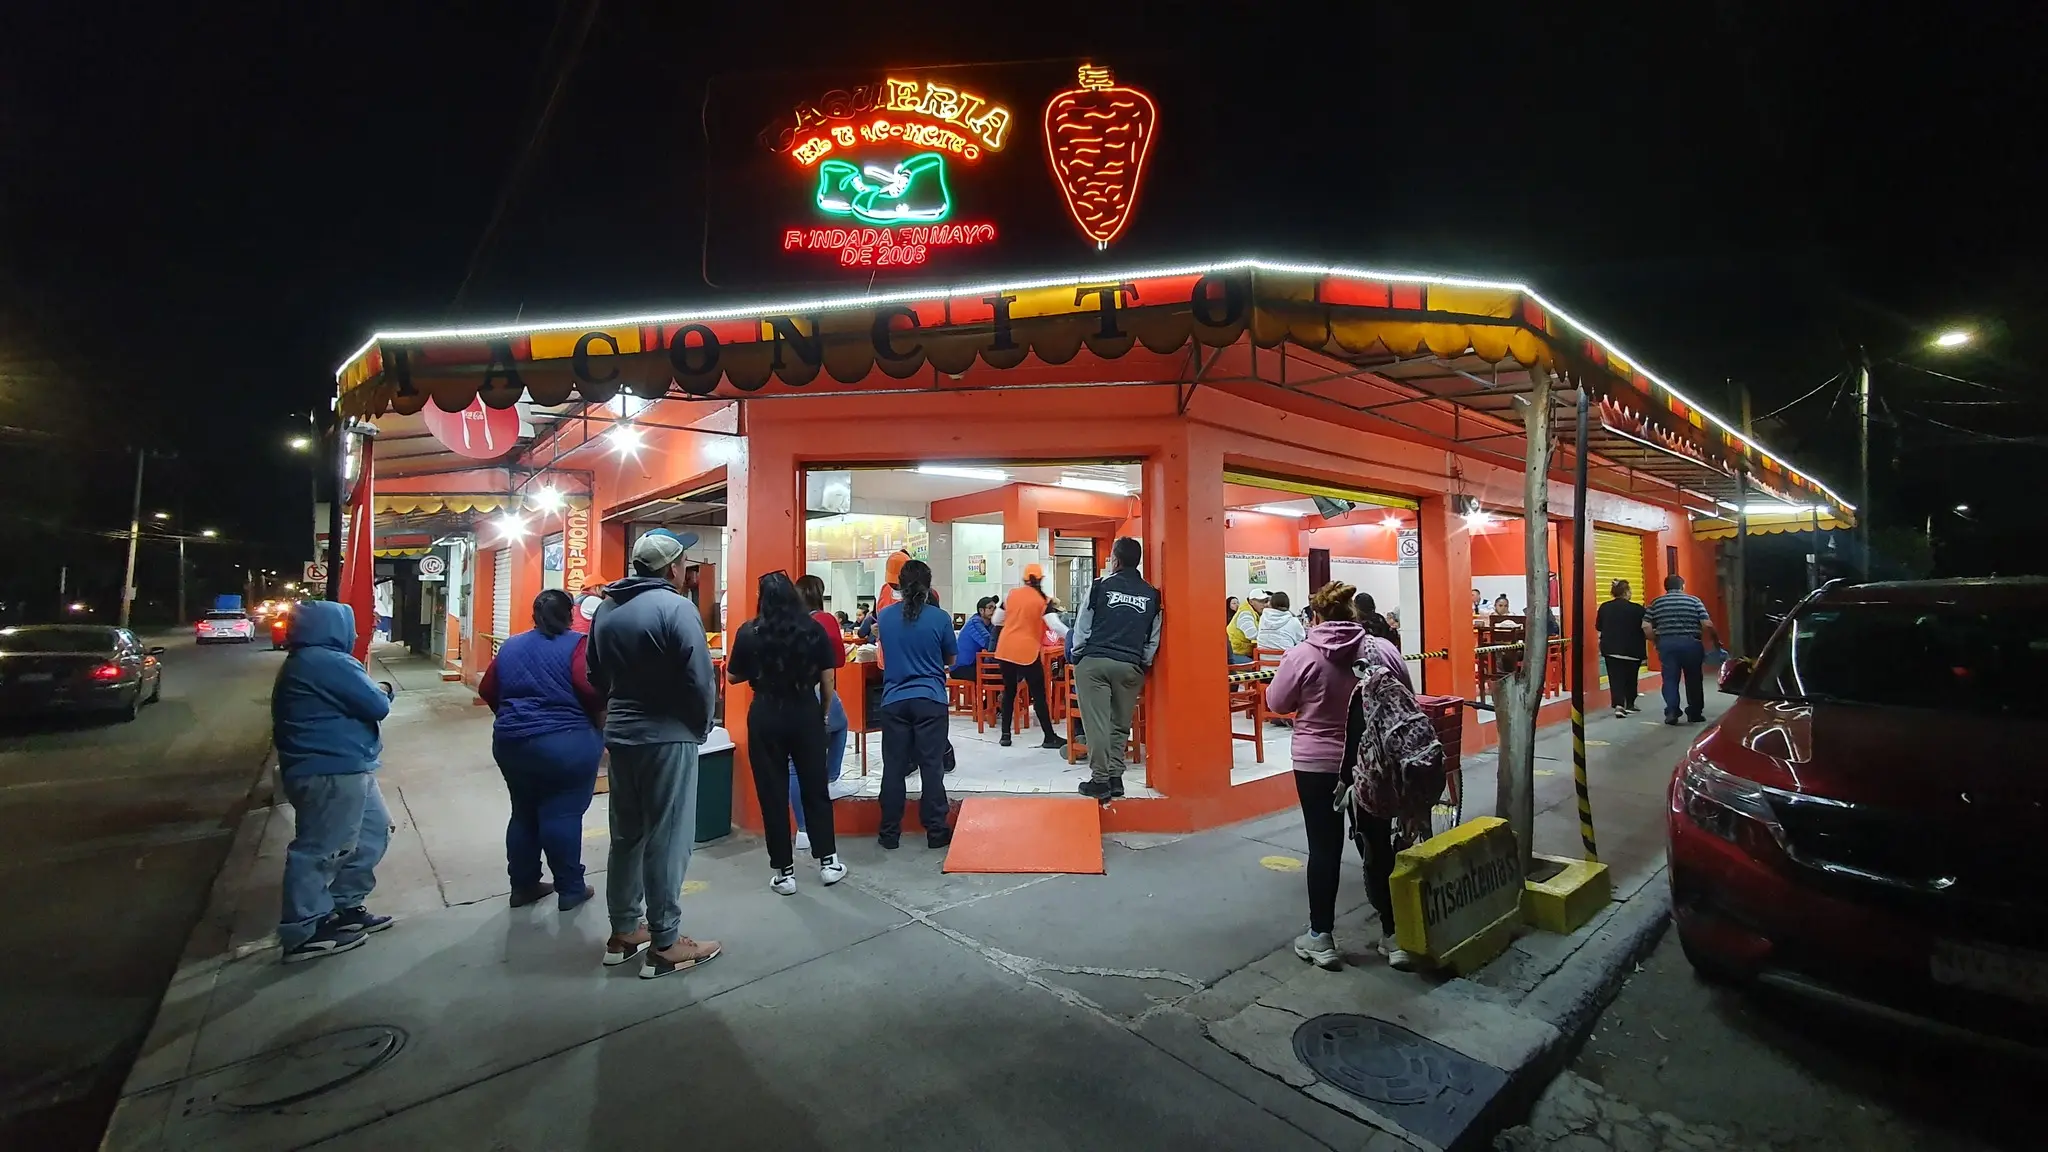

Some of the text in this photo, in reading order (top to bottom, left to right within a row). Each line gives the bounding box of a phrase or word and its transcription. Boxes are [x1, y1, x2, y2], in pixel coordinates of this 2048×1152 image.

[792, 137, 833, 165] EL
[928, 223, 996, 246] MAYO
[840, 247, 875, 267] DE
[383, 272, 1251, 398] TACONCITO
[569, 549, 585, 558] AL
[1106, 590, 1150, 611] EAGLES
